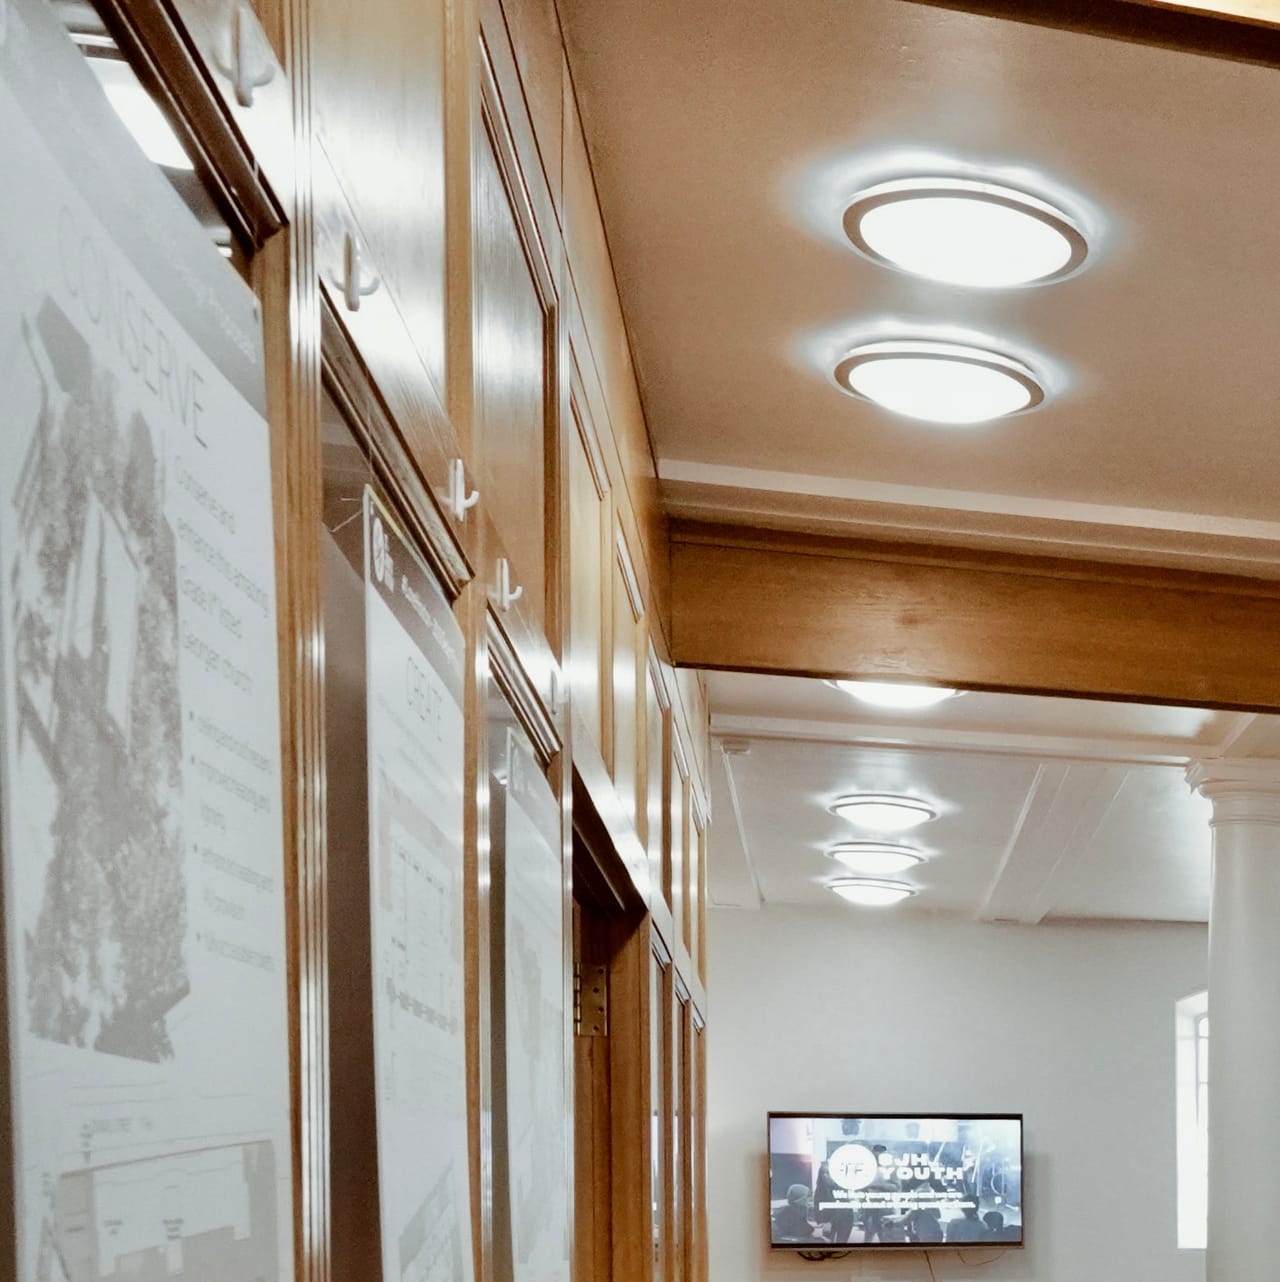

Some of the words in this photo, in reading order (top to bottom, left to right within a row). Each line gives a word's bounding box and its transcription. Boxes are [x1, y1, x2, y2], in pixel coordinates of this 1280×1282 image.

[56, 202, 208, 450] CONSERVE
[878, 1152, 930, 1167] SJH
[879, 1167, 964, 1180] YOUTH
